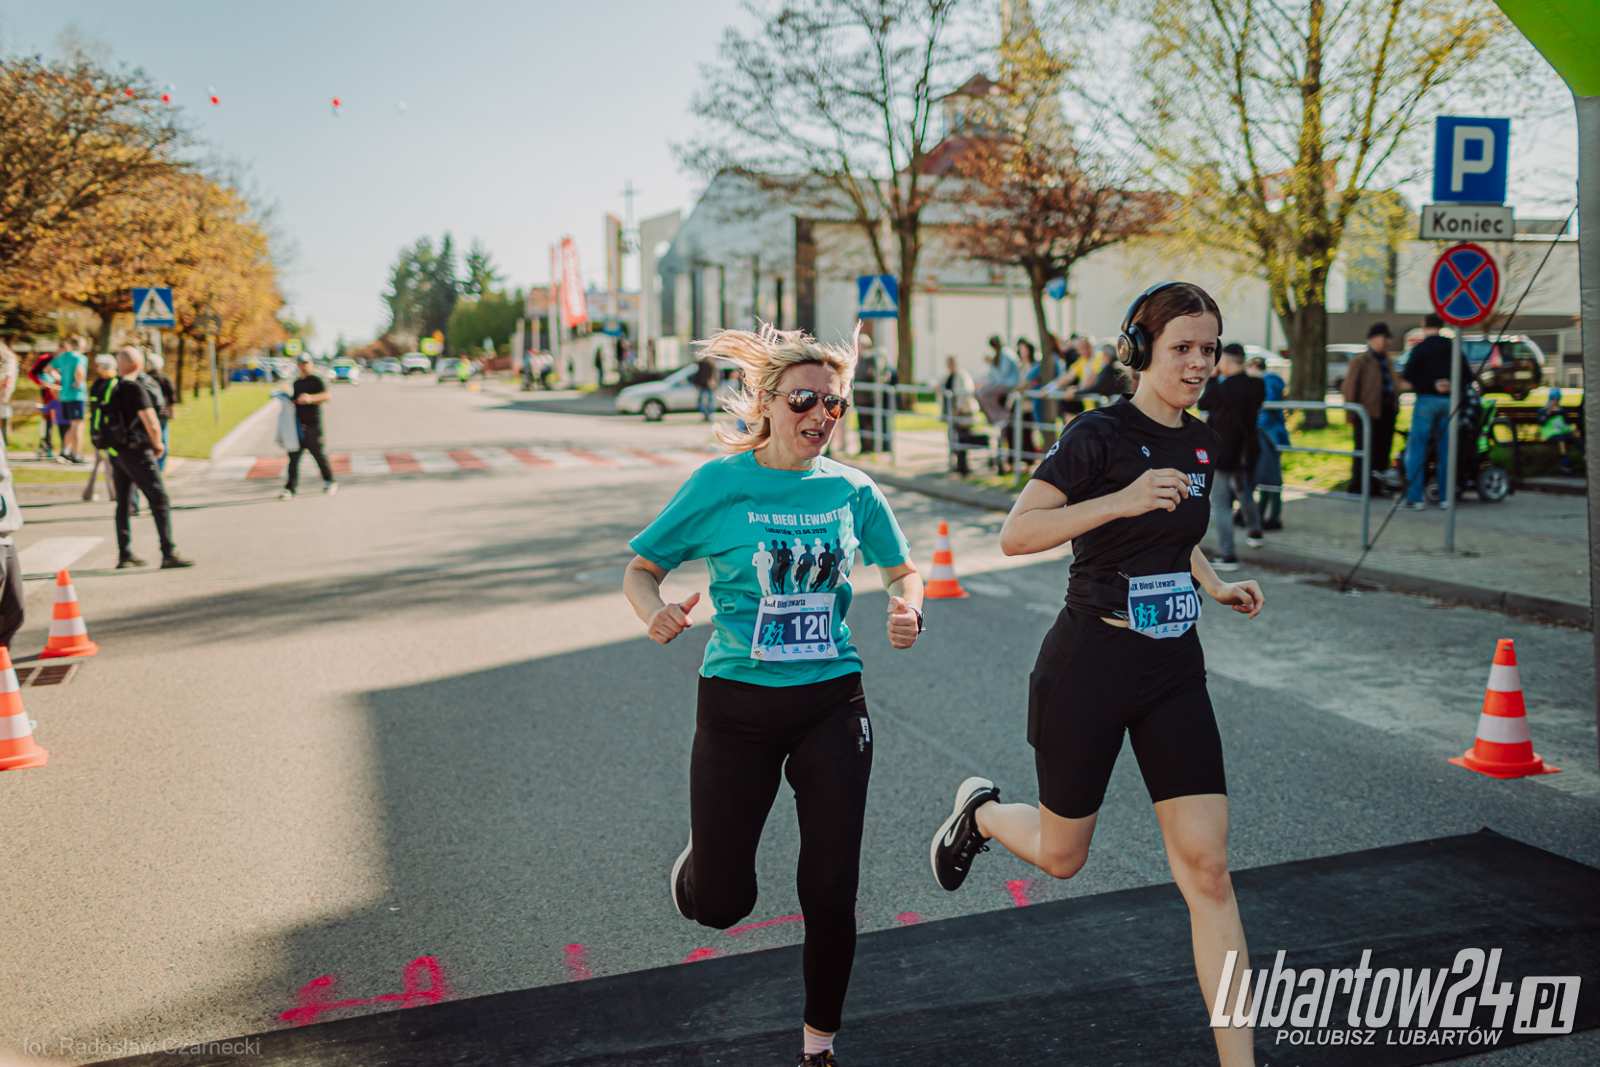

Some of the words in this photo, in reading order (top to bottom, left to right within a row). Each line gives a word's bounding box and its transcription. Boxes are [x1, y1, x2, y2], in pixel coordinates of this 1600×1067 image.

[1451, 125, 1495, 192] P
[1432, 211, 1504, 233] Koniec
[772, 513, 798, 526] BIEGI
[1165, 593, 1196, 620] 150
[791, 614, 828, 641] 120
